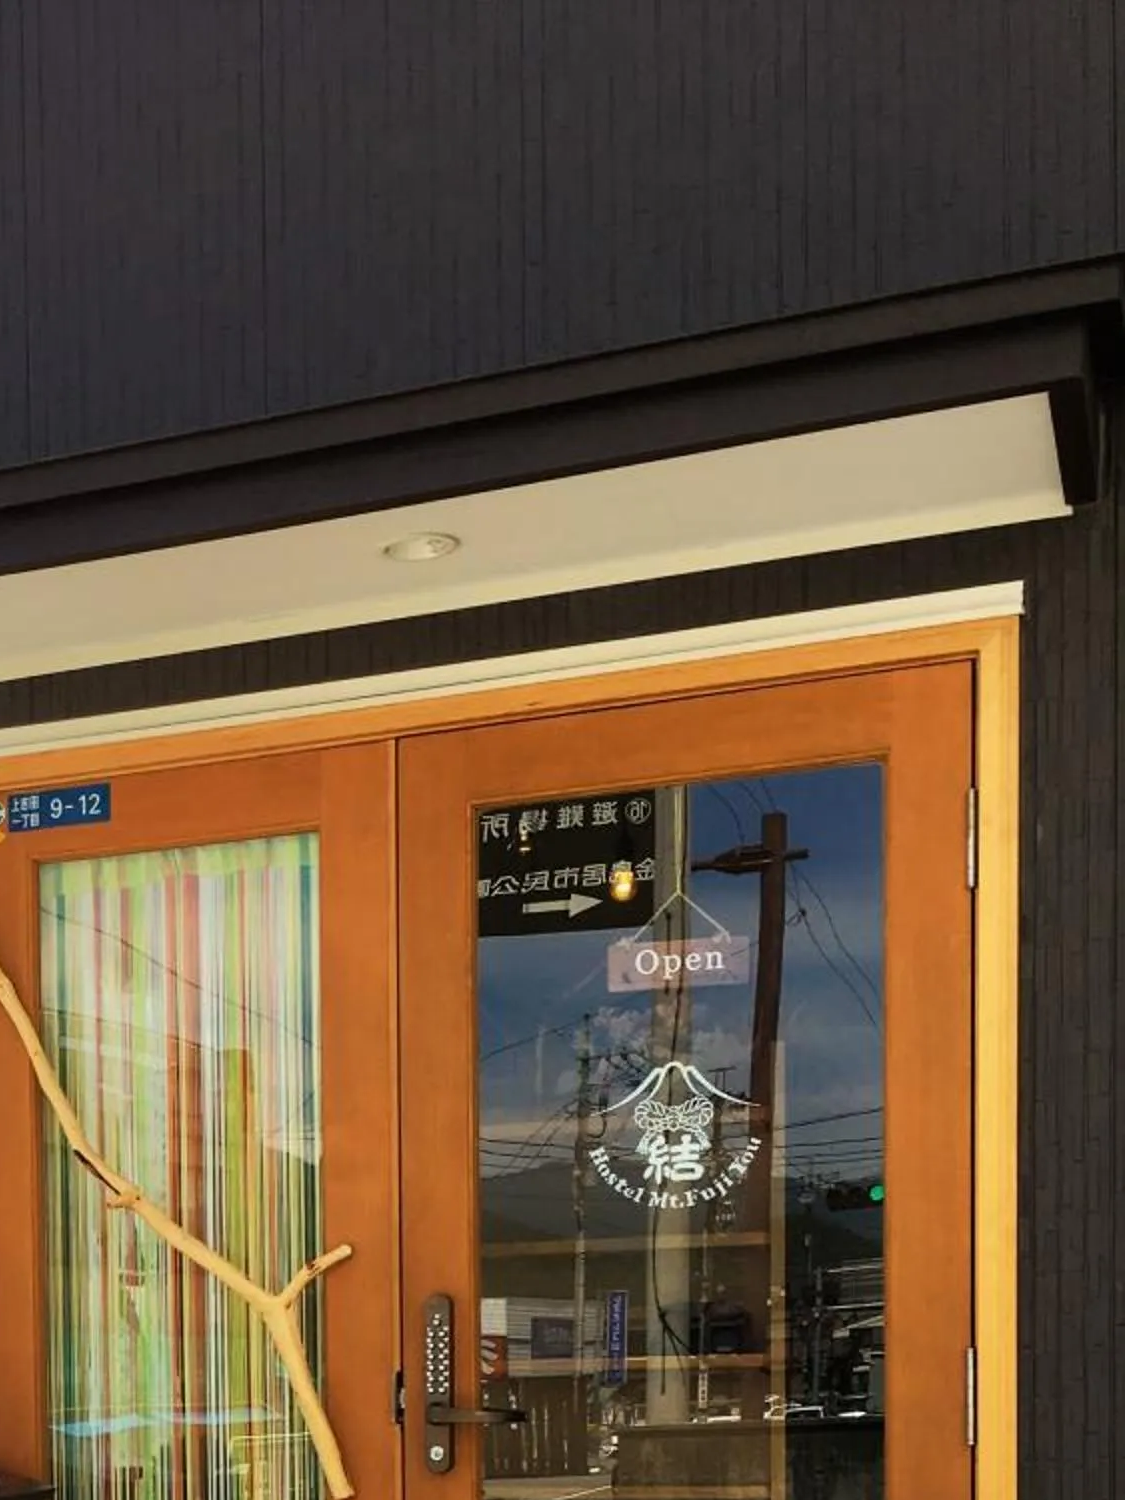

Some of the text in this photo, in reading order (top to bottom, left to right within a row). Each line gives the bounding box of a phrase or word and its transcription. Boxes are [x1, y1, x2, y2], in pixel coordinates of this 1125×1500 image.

[11, 812, 40, 828] 一丁目
[50, 793, 101, 819] 9-12
[635, 949, 725, 979] Open
[643, 1133, 705, 1185] 結
[589, 1147, 645, 1203] Hostel
